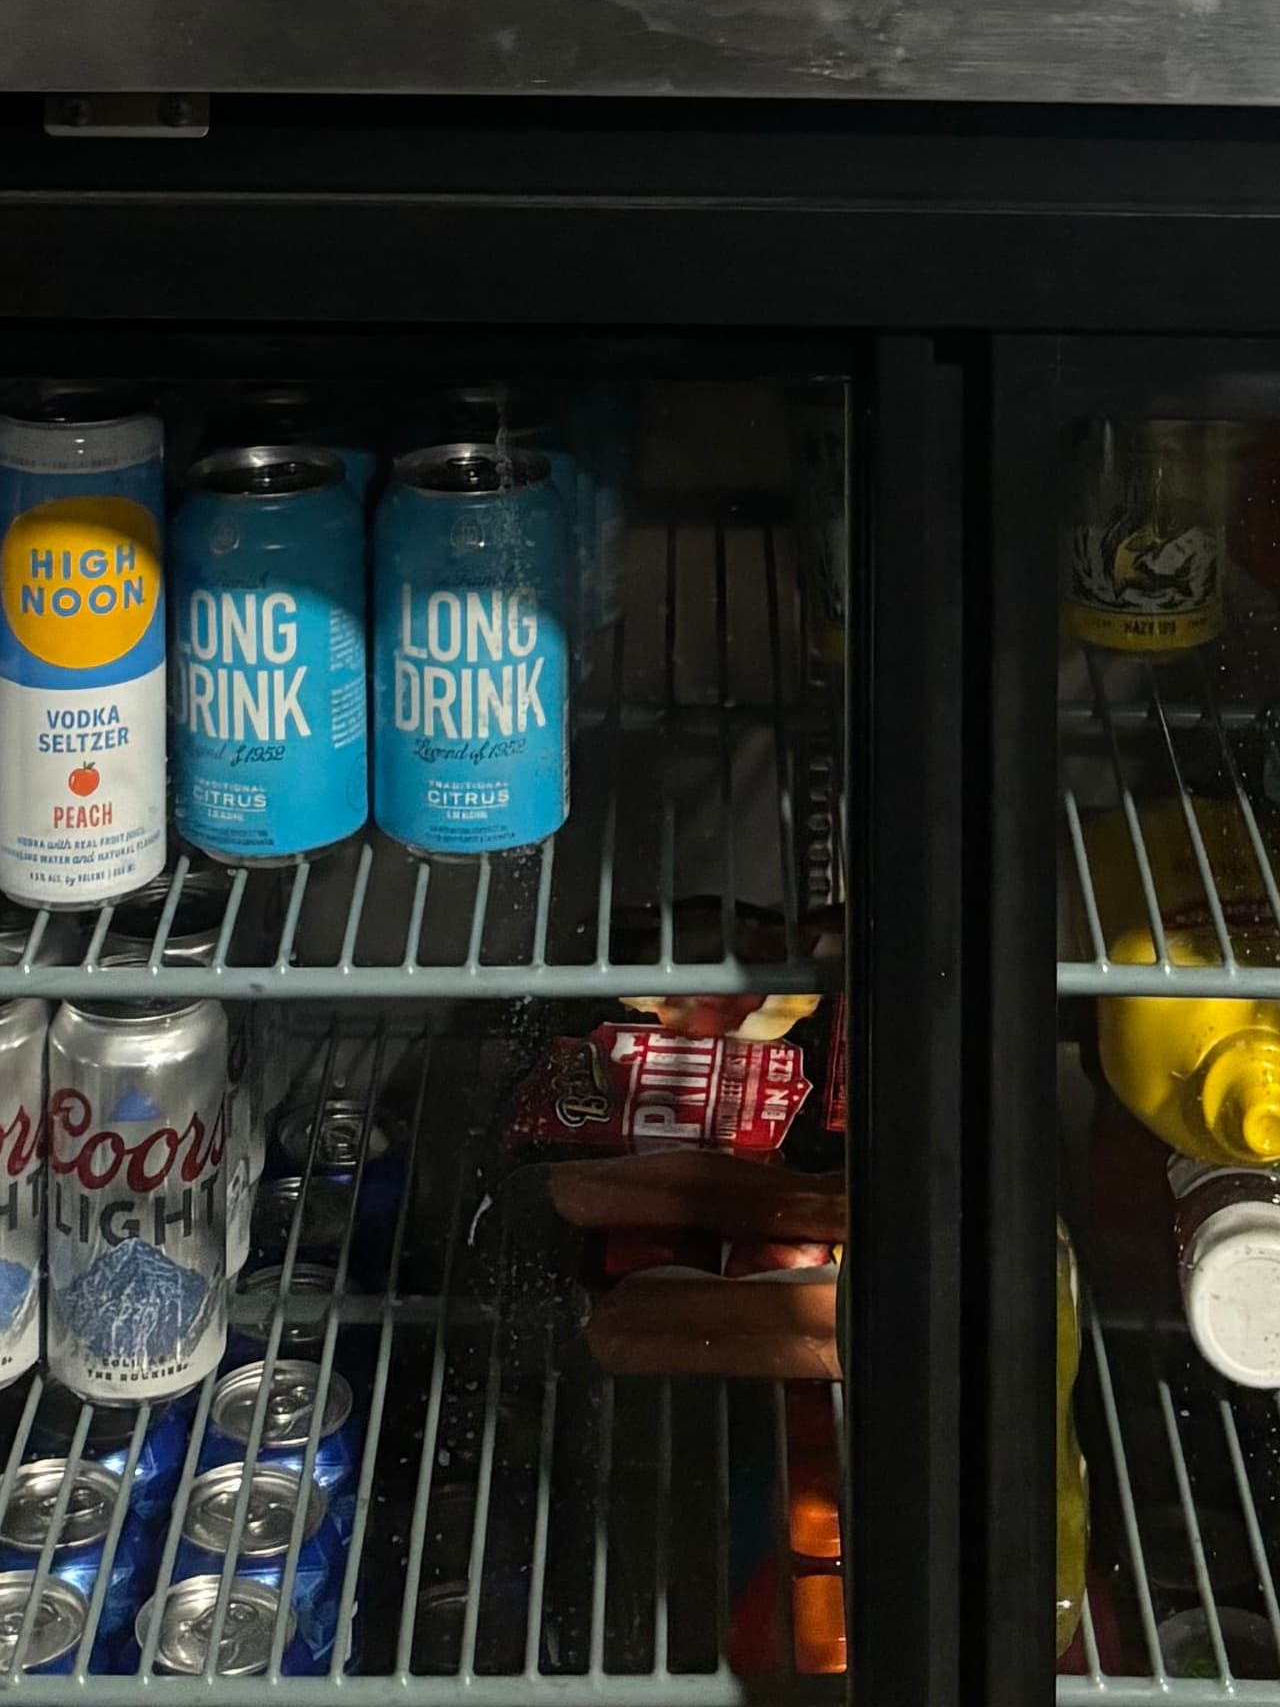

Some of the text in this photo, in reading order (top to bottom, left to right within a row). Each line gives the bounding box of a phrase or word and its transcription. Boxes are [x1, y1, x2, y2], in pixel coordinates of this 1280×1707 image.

[30, 543, 137, 581] HIGH
[22, 576, 145, 618] NOON
[401, 582, 538, 663] LONG
[394, 657, 547, 740] DRINK
[46, 705, 121, 730] VODKA
[38, 727, 129, 754] SELTZER
[242, 744, 286, 763] 1952
[413, 738, 465, 766] Legend
[427, 790, 510, 807] CITRUS
[428, 779, 511, 792] TRADITIONAL
[192, 790, 267, 810] CITRUS
[53, 803, 113, 829] PEACH
[766, 1047, 795, 1084] SIZE
[56, 1173, 219, 1248] LIGHT
